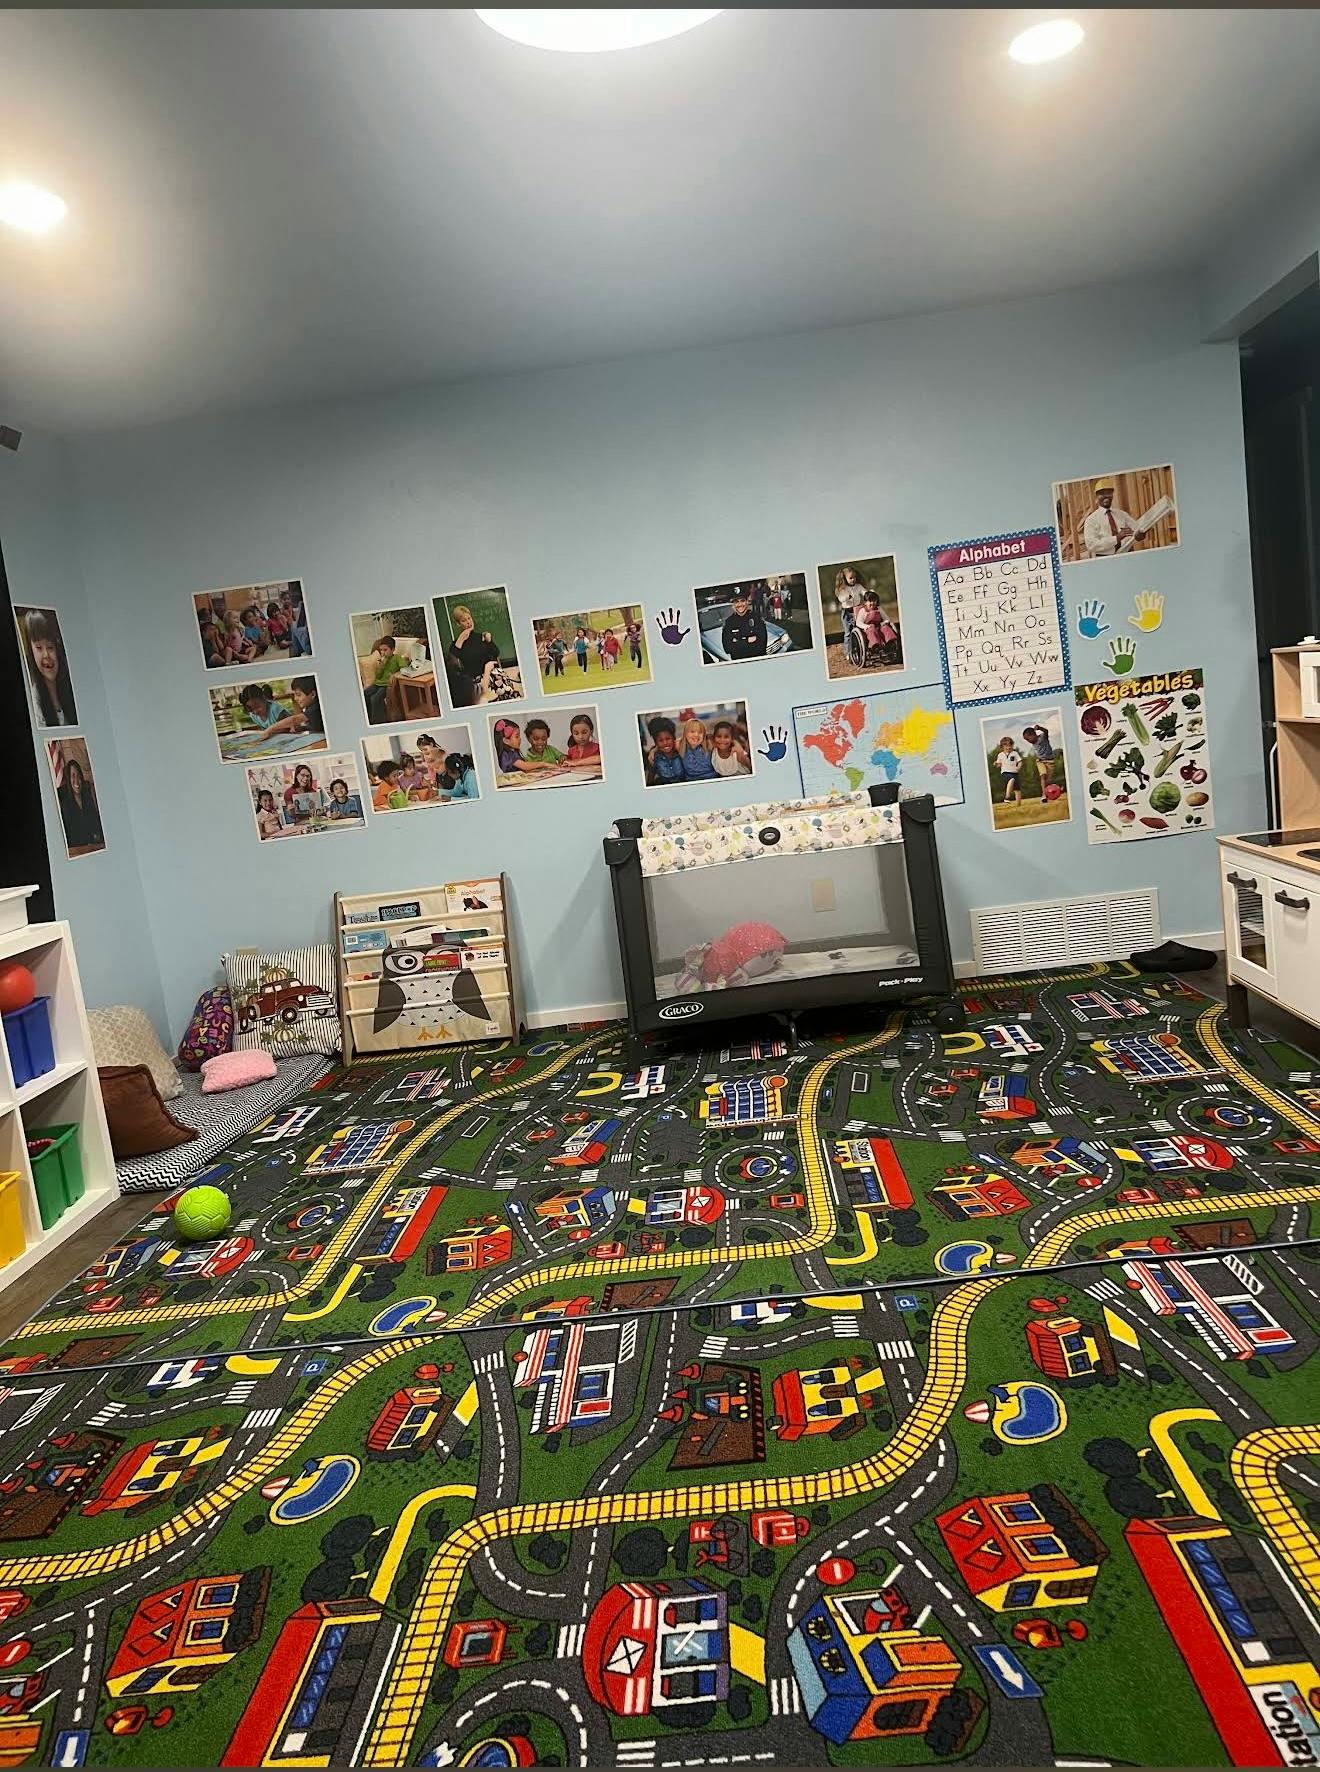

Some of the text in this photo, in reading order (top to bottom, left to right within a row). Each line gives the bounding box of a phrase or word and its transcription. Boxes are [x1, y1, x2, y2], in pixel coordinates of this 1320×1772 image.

[959, 540, 1026, 563] Alphabet
[943, 557, 1047, 586] Aa Bb Cc Dd
[947, 576, 1047, 604] Ee Ff Gg Hh
[955, 595, 1044, 623] Ii Jj Kk Ll
[958, 615, 1046, 640] Mm Nn Oo
[955, 632, 1053, 663] Pp Qq Rr Ss
[953, 651, 1059, 678] Tt Uu Vv Ww
[973, 671, 1043, 694] Xx Yy Zz
[1084, 674, 1194, 705] Vegetables
[664, 1004, 700, 1016] GRACO
[1263, 1691, 1318, 1767] tation
